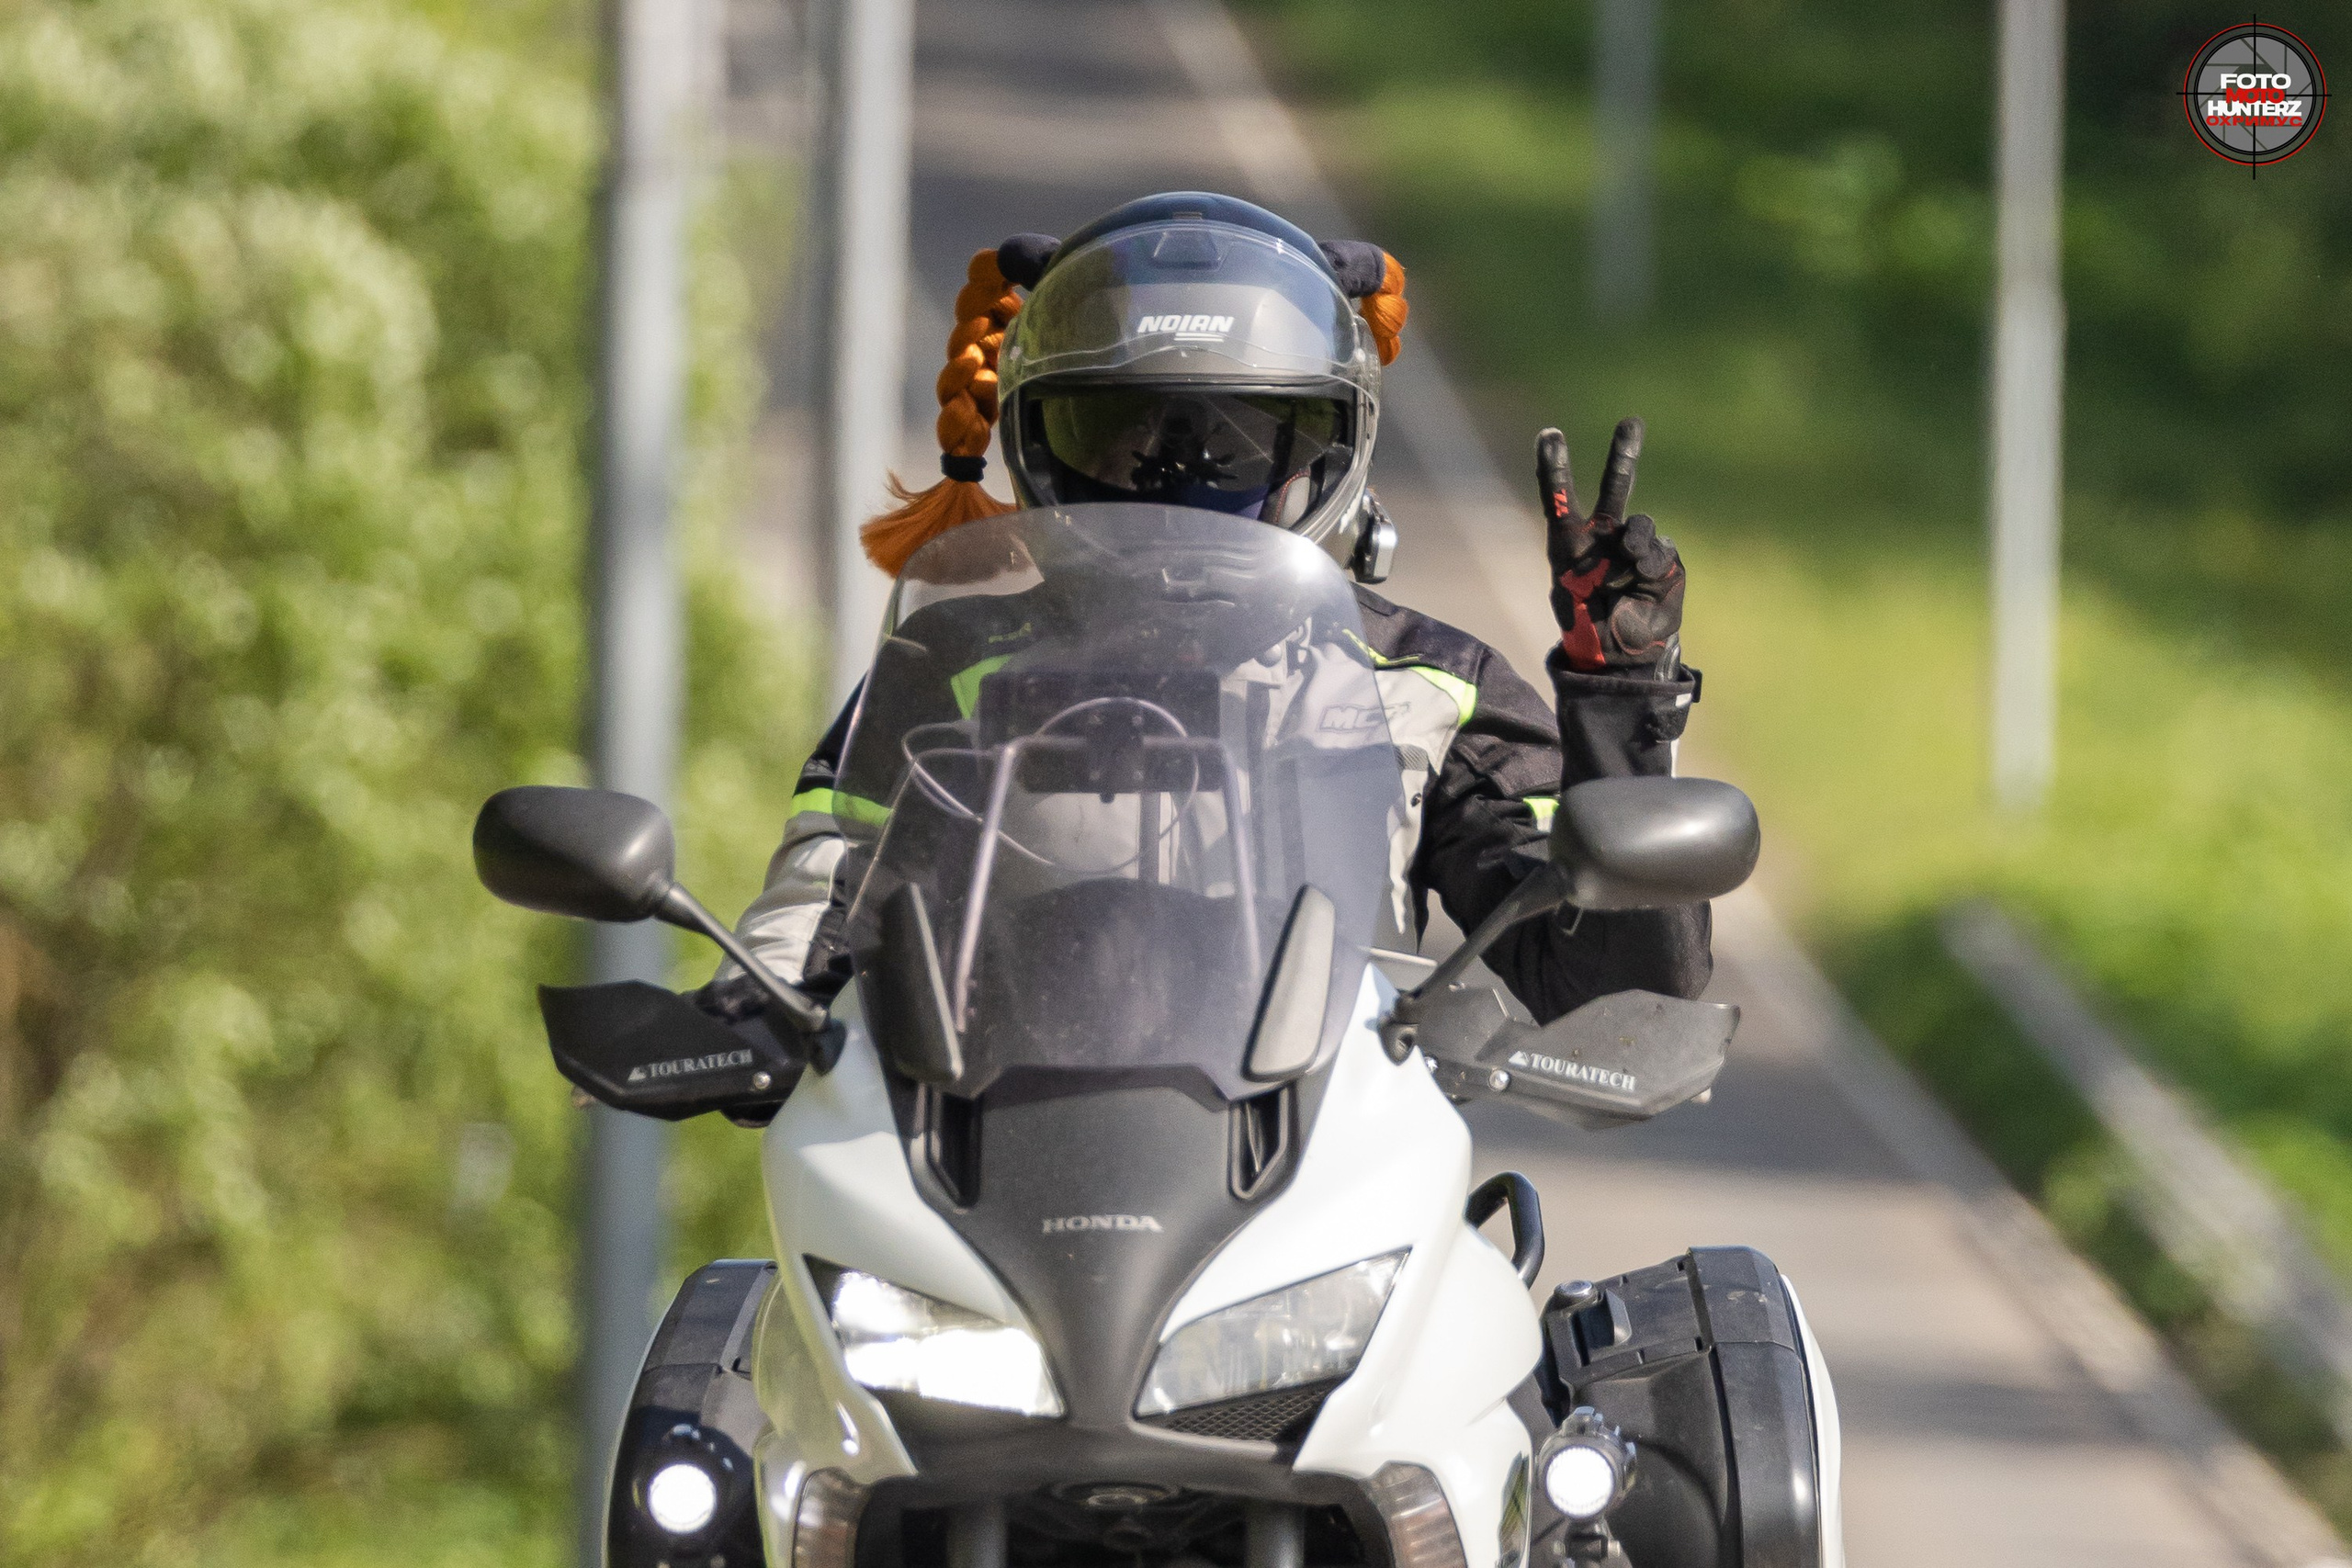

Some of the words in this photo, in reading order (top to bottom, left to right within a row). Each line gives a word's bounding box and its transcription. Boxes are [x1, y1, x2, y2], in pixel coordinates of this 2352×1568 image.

[648, 1049, 753, 1077] TOURATECH
[1530, 1053, 1636, 1092] TOURATECH
[1042, 1214, 1164, 1235] HONDA
